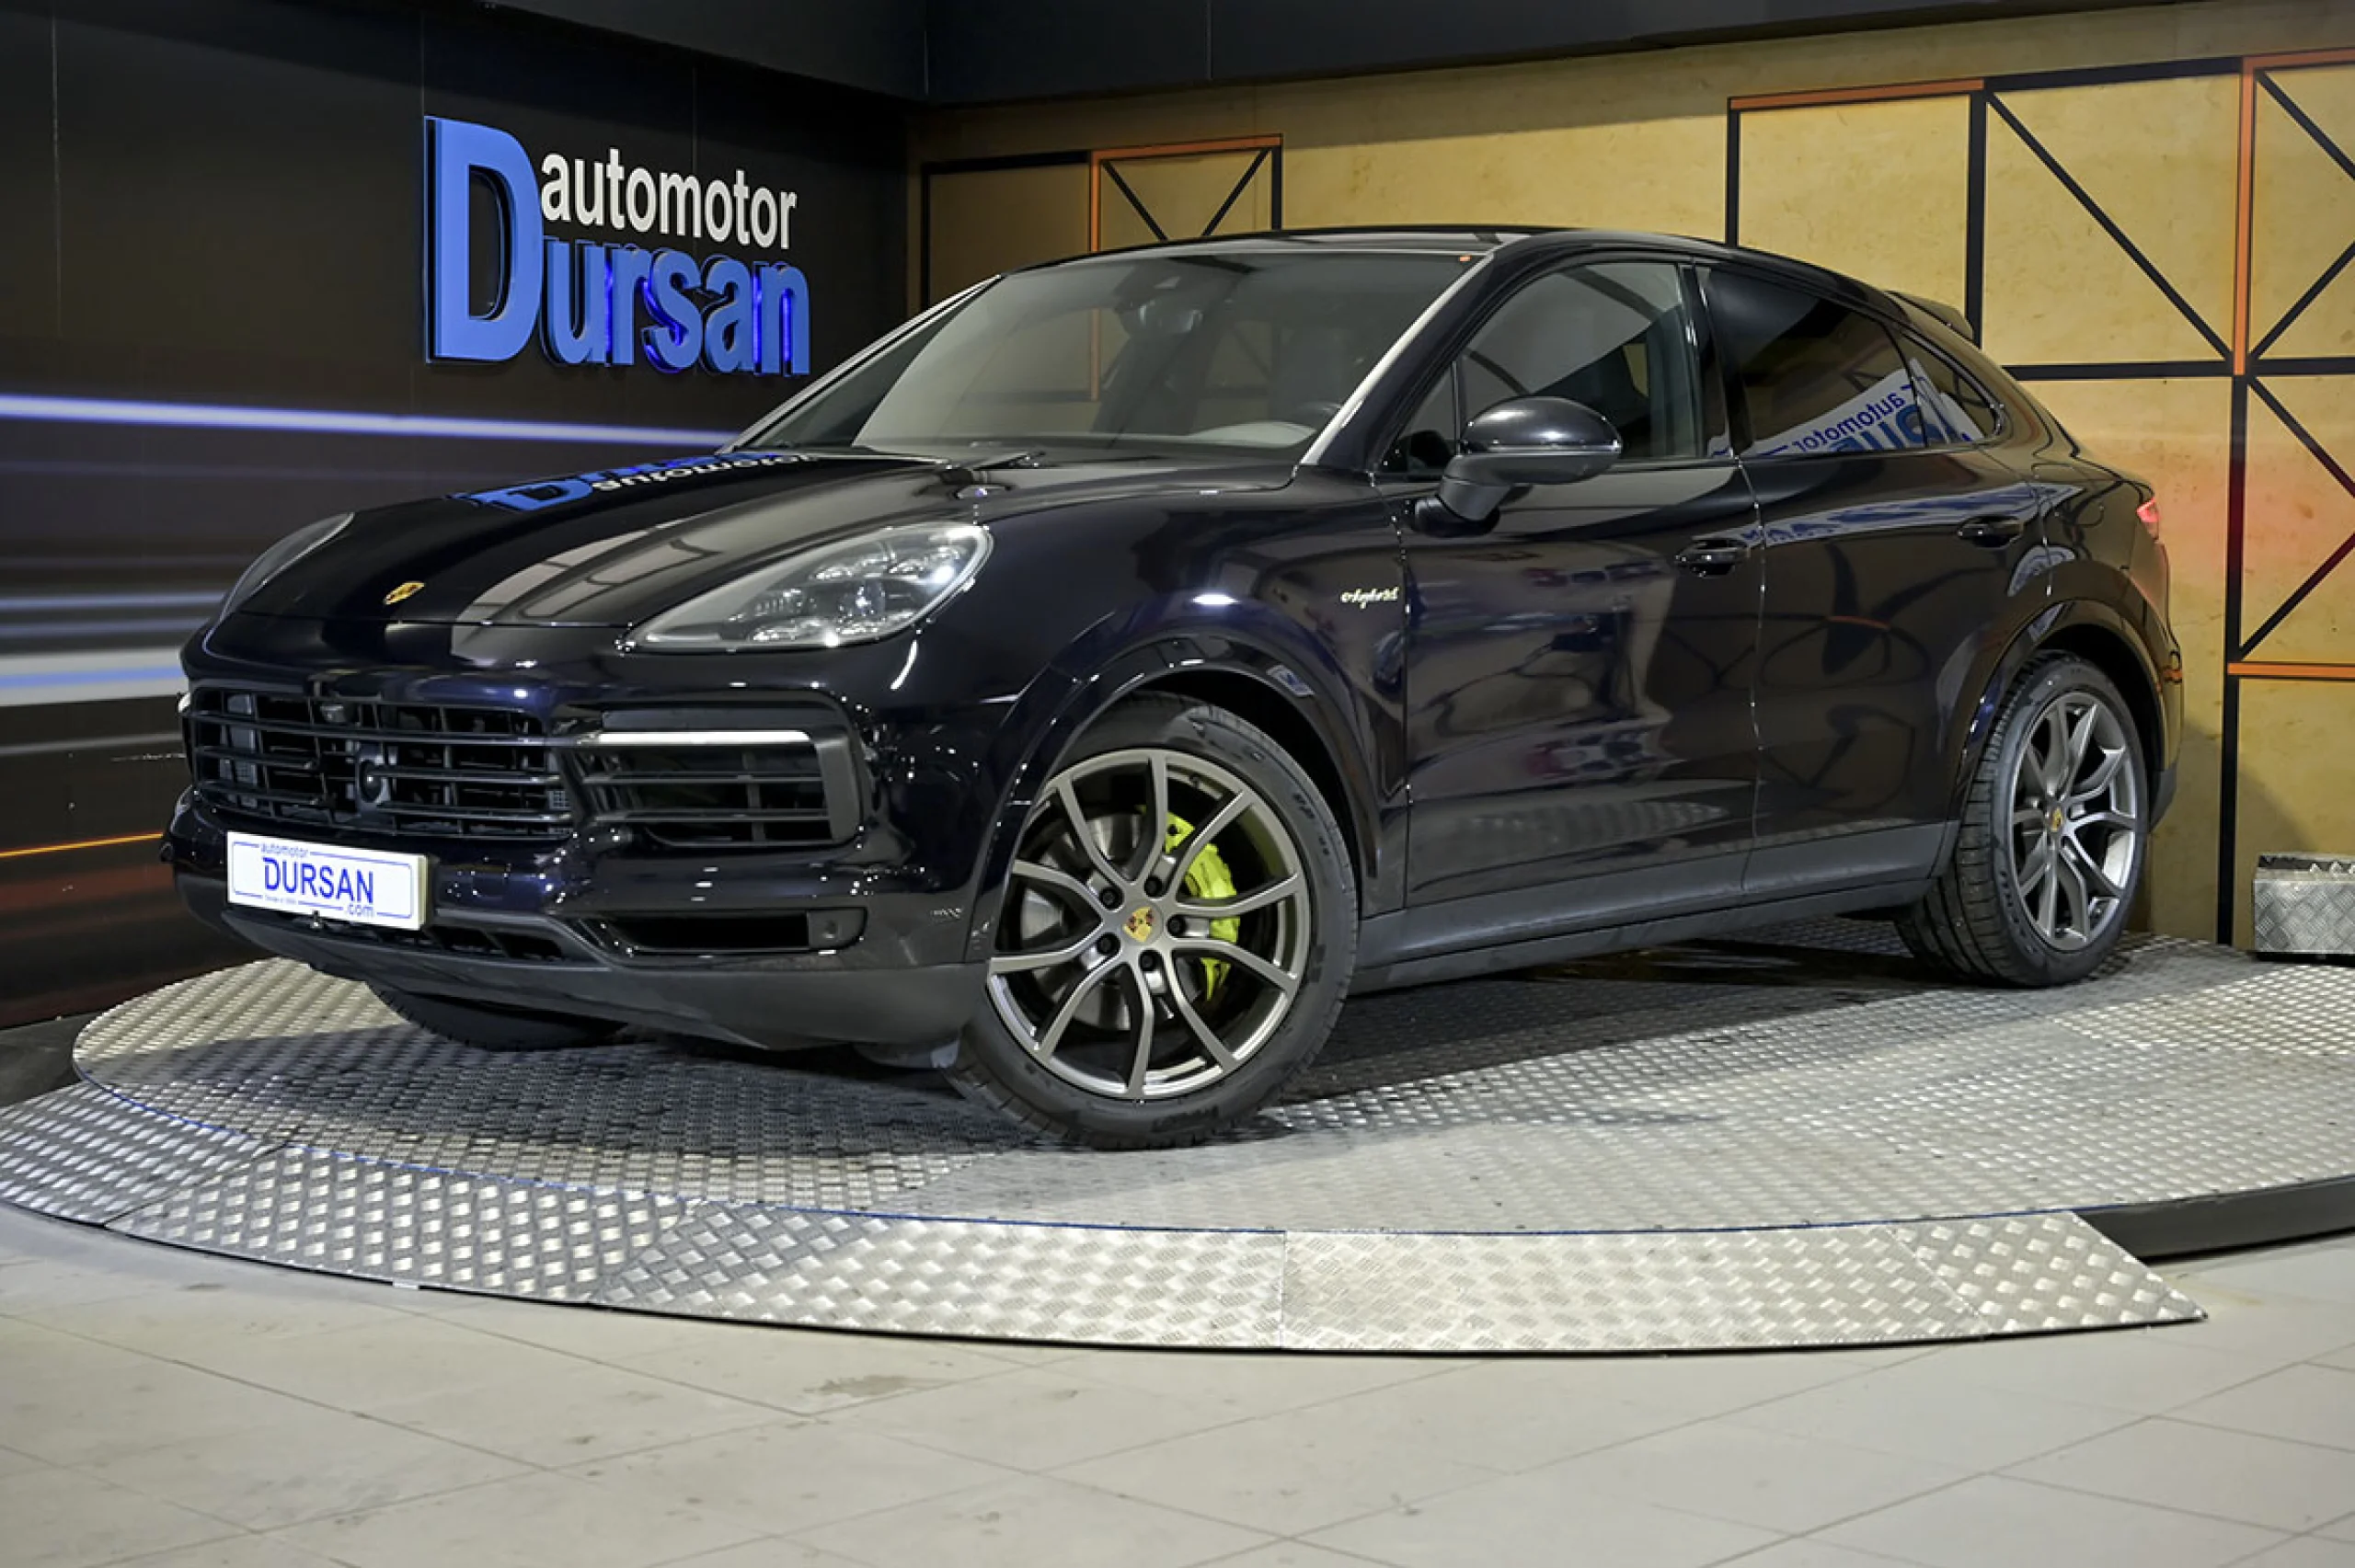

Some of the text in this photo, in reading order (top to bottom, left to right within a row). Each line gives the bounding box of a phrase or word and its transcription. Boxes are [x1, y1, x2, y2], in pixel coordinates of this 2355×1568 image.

[424, 116, 810, 376] Dursan
[541, 147, 797, 249] automotor
[262, 856, 373, 904] DURSAN
